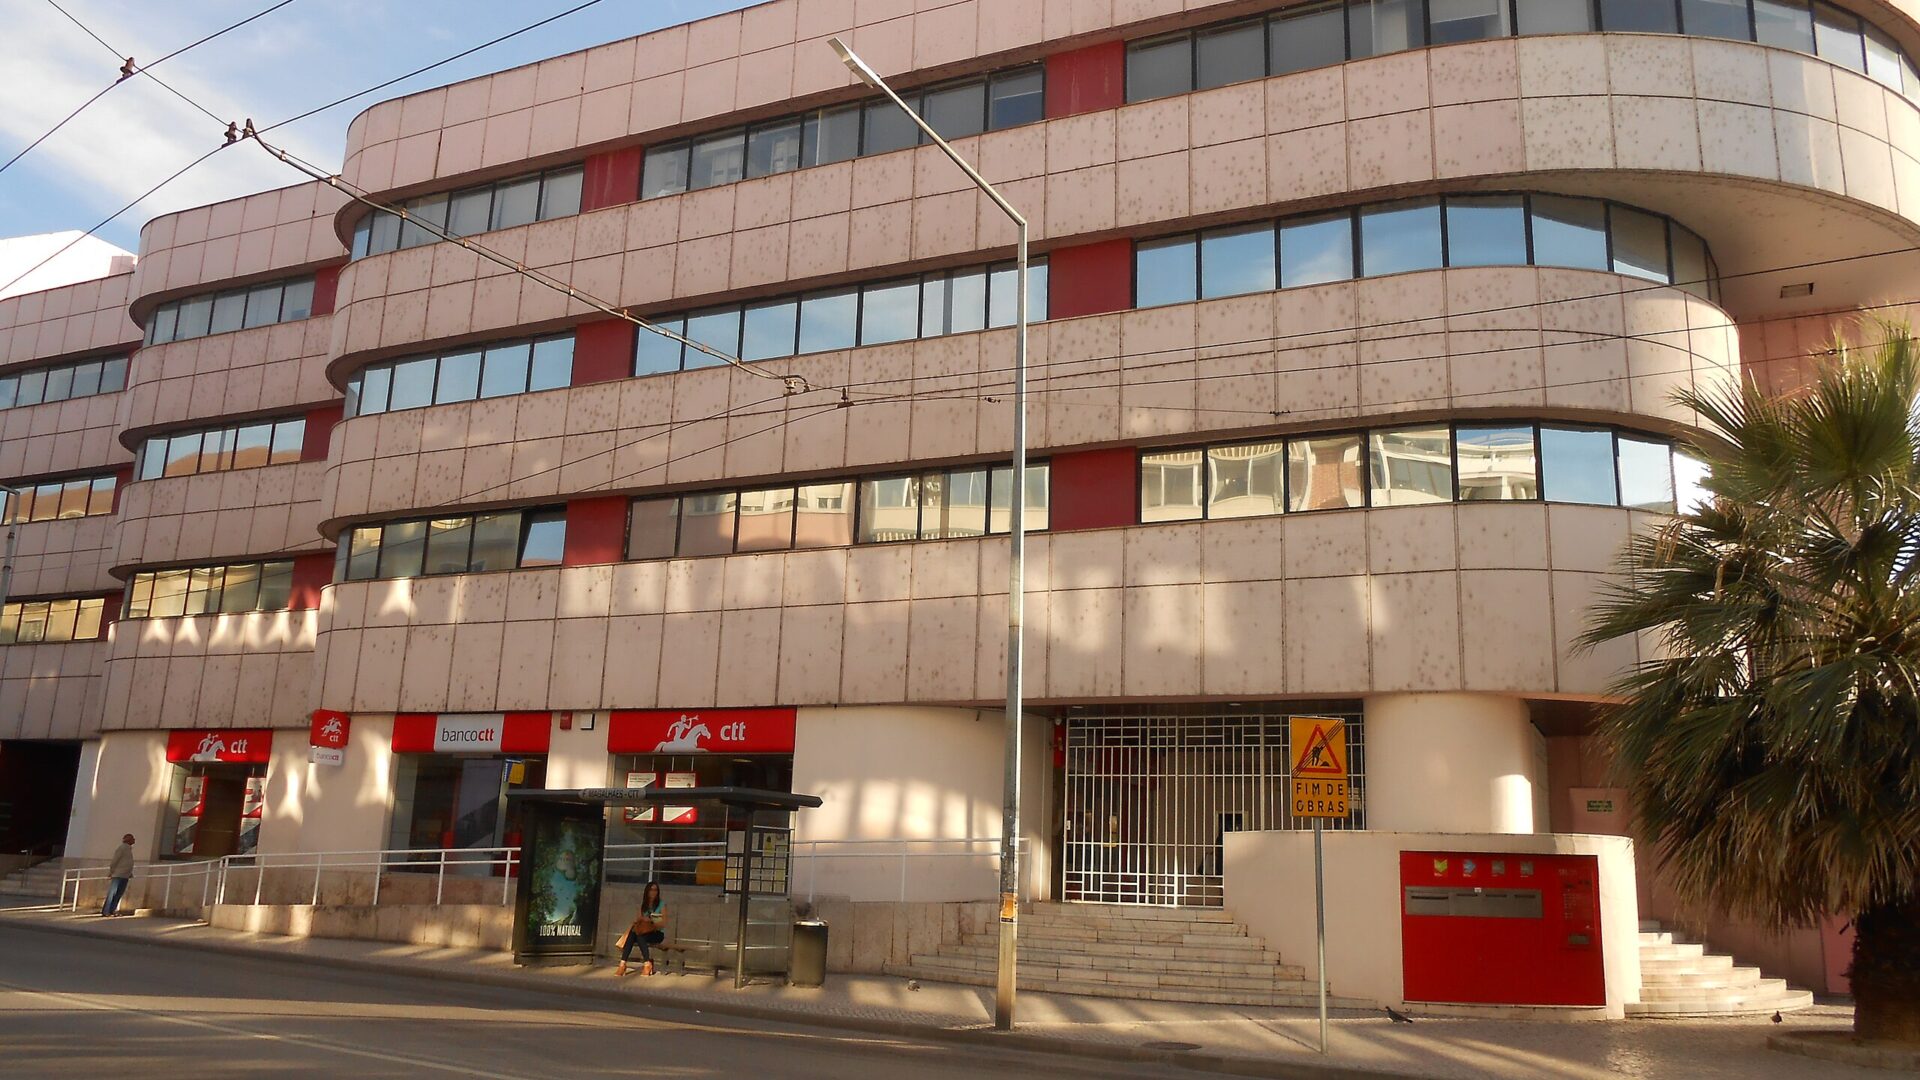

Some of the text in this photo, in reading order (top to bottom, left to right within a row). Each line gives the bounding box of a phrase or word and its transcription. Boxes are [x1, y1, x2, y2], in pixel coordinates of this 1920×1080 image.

[720, 721, 746, 741] ctt
[230, 739, 248, 754] ctt
[1296, 782, 1344, 796] FIM DE
[1296, 800, 1345, 813] OBRAS
[540, 924, 581, 937] 100% NATURAL
